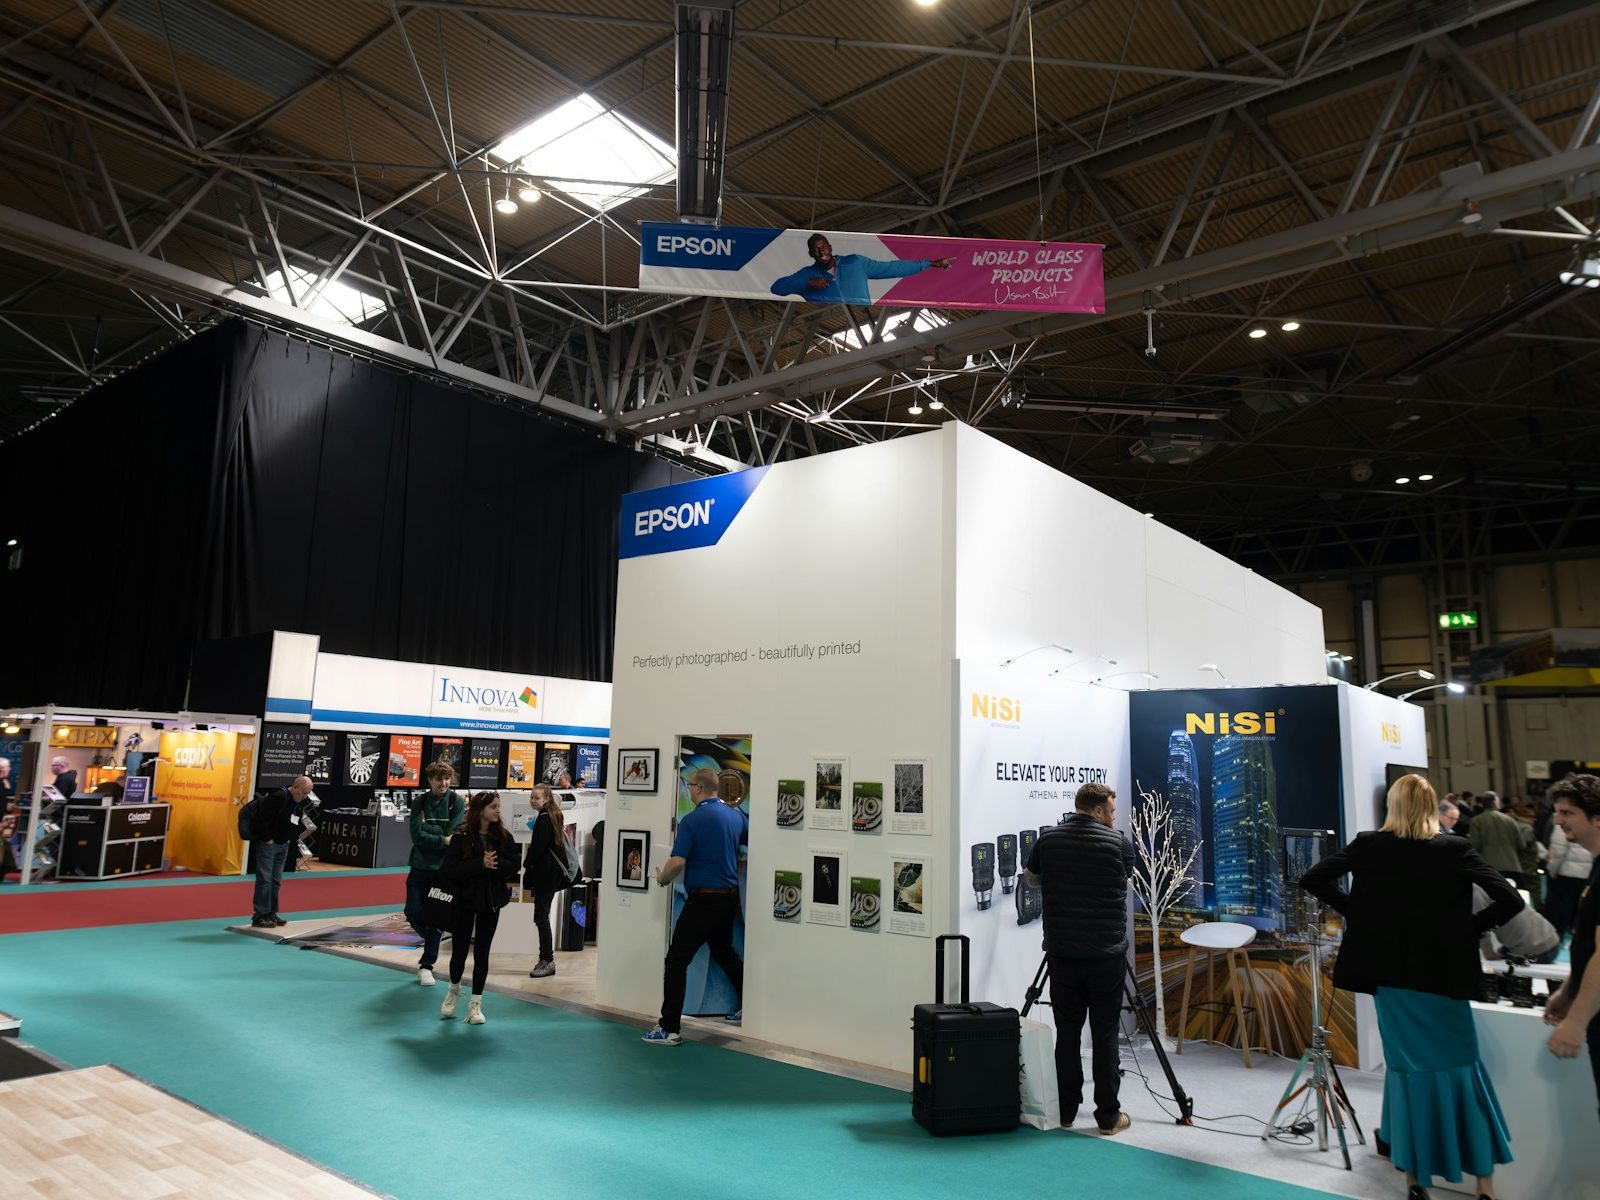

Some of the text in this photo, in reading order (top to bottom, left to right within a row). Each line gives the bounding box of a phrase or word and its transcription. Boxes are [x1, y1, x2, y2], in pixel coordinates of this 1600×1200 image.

[657, 236, 732, 257] EPSON
[972, 250, 1084, 266] WORLD CLASS
[990, 268, 1074, 284] PRODUCTS
[634, 500, 710, 536] EPSON
[632, 655, 674, 669] Perfectly
[675, 648, 748, 668] photographed
[759, 644, 815, 660] beautifully
[818, 640, 861, 658] printed
[439, 678, 518, 708] INNOVA
[971, 692, 1021, 722] NiSi
[460, 721, 515, 730] www.innovaart.com
[1186, 712, 1276, 734] NiSi
[580, 748, 599, 756] Olmec
[996, 762, 1107, 784] ELEVATE YOUR STORY
[1029, 790, 1076, 800] ATHENA PRI
[331, 842, 358, 856] FOTO
[428, 886, 453, 903] Nikon
